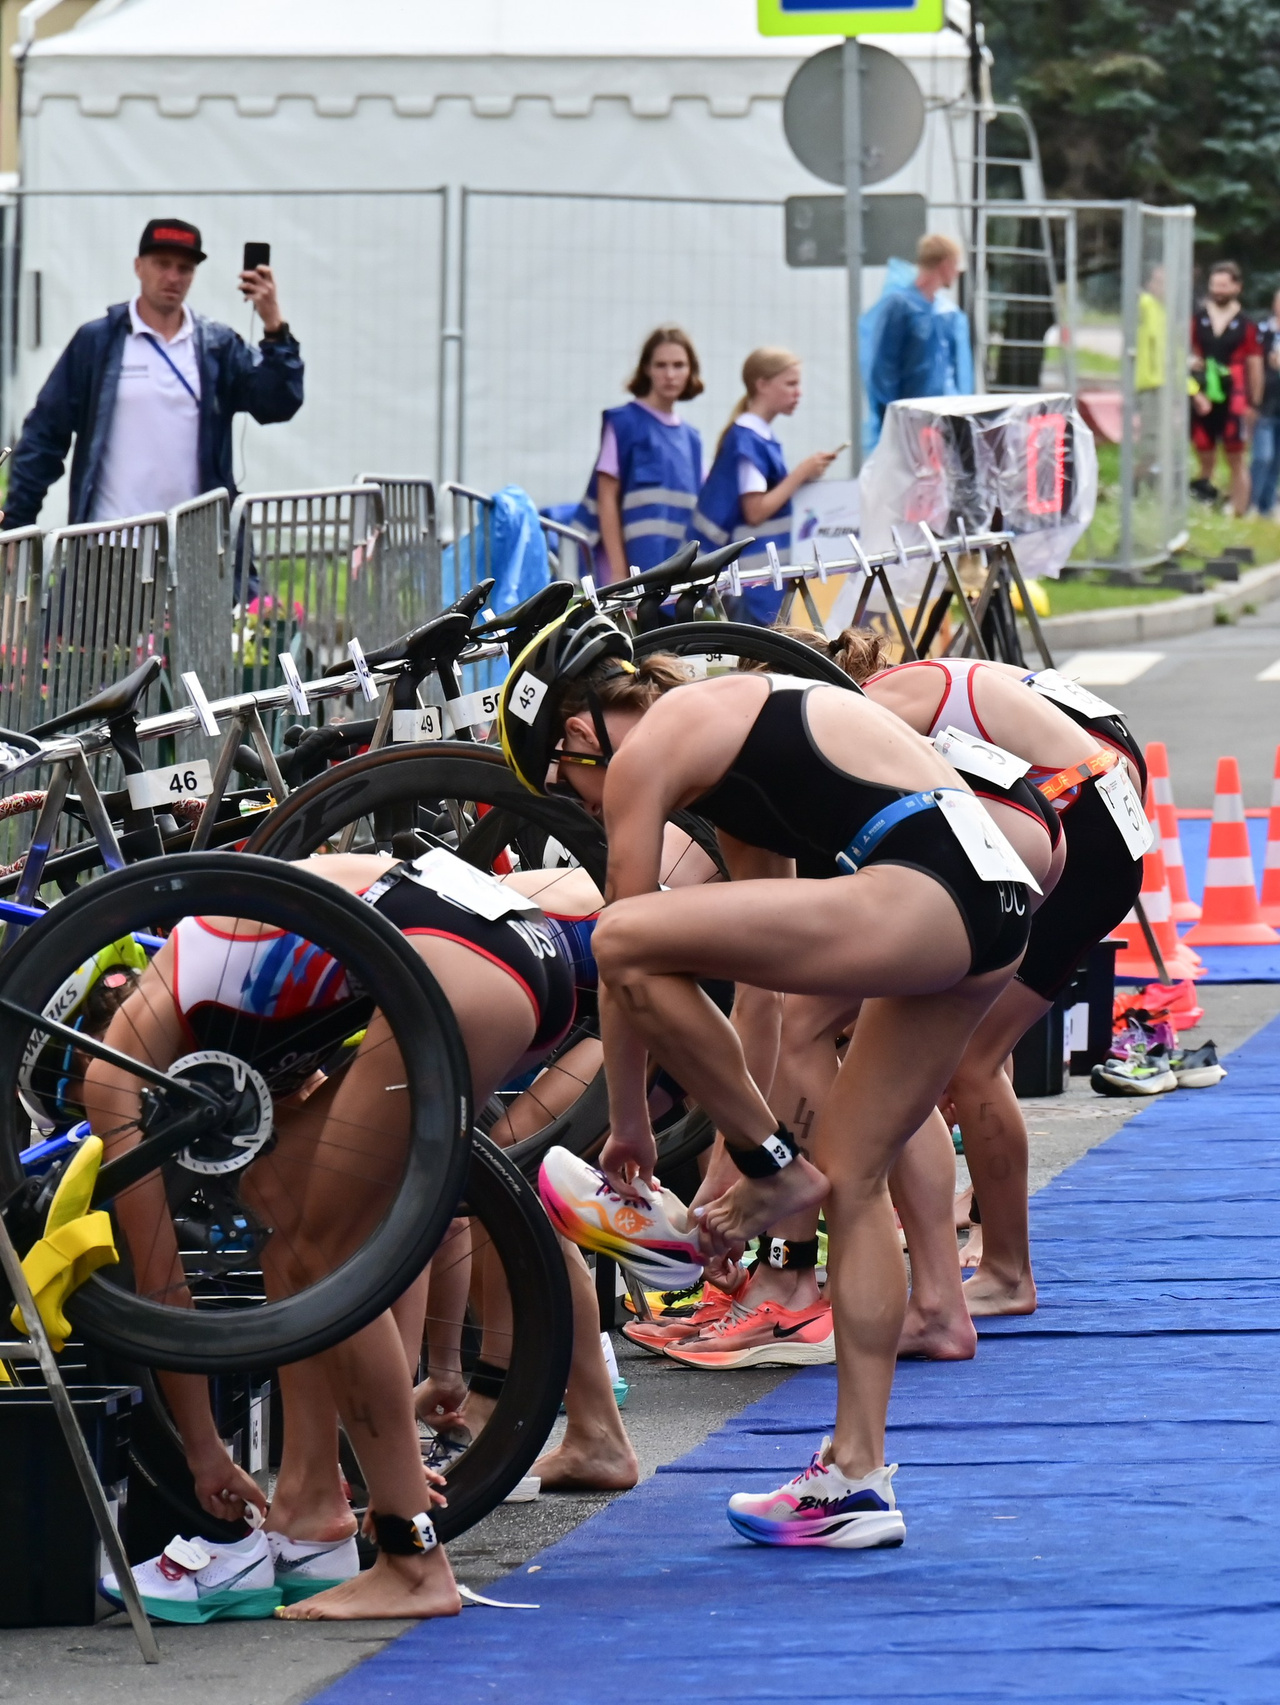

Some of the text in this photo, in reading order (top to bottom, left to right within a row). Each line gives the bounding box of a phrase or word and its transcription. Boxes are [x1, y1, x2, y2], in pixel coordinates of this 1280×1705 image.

[519, 685, 536, 710] 45
[420, 714, 434, 734] 49
[169, 770, 197, 793] 46
[773, 1145, 787, 1160] 45
[772, 1245, 781, 1260] 49
[422, 1525, 434, 1543] 44
